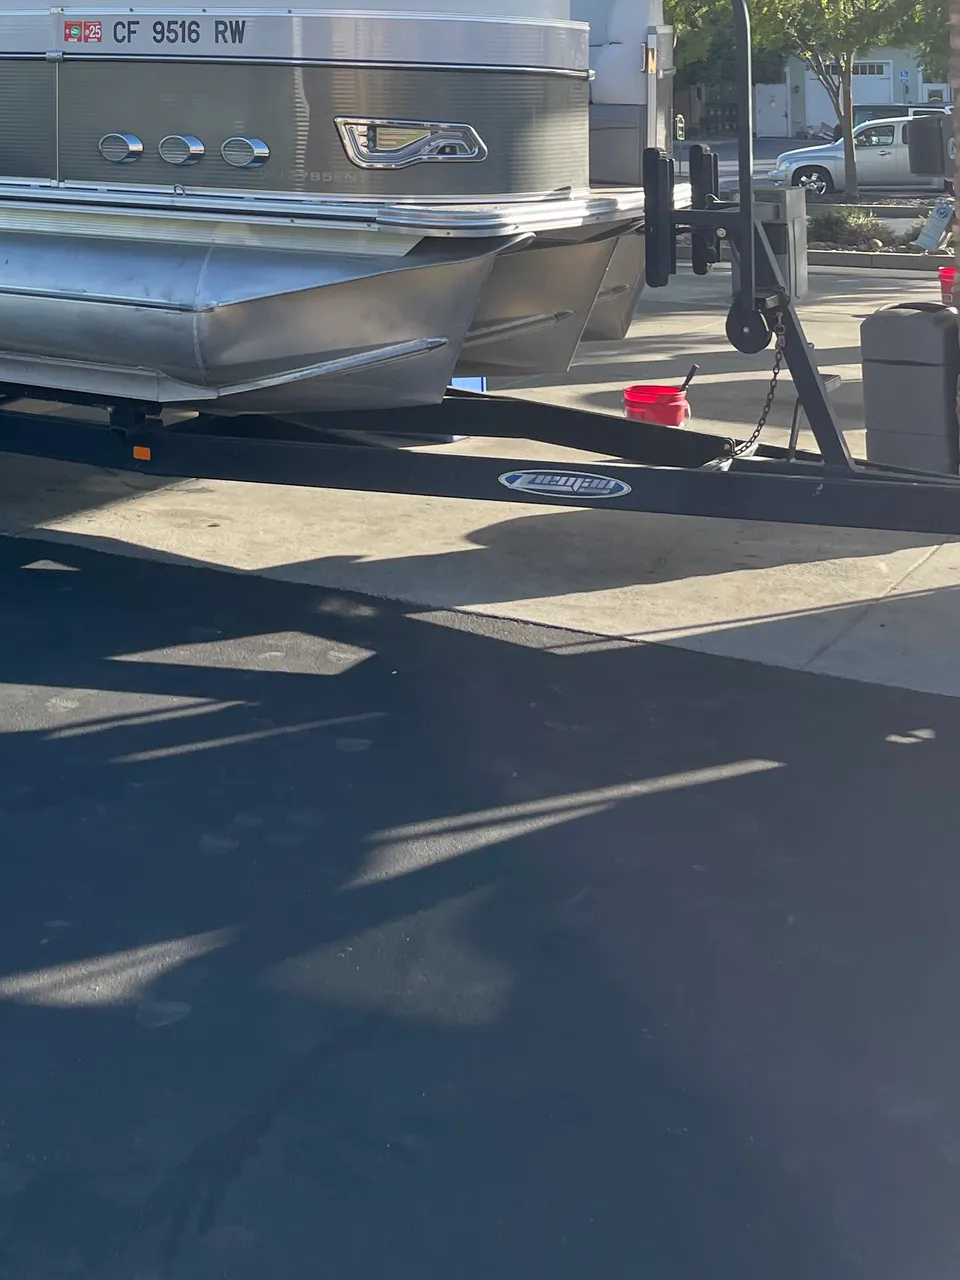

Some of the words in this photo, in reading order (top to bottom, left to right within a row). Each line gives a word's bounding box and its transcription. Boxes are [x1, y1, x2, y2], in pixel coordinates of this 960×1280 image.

[89, 25, 101, 38] 25
[113, 20, 140, 44] CF
[152, 20, 200, 44] 9516
[214, 20, 246, 44] RW
